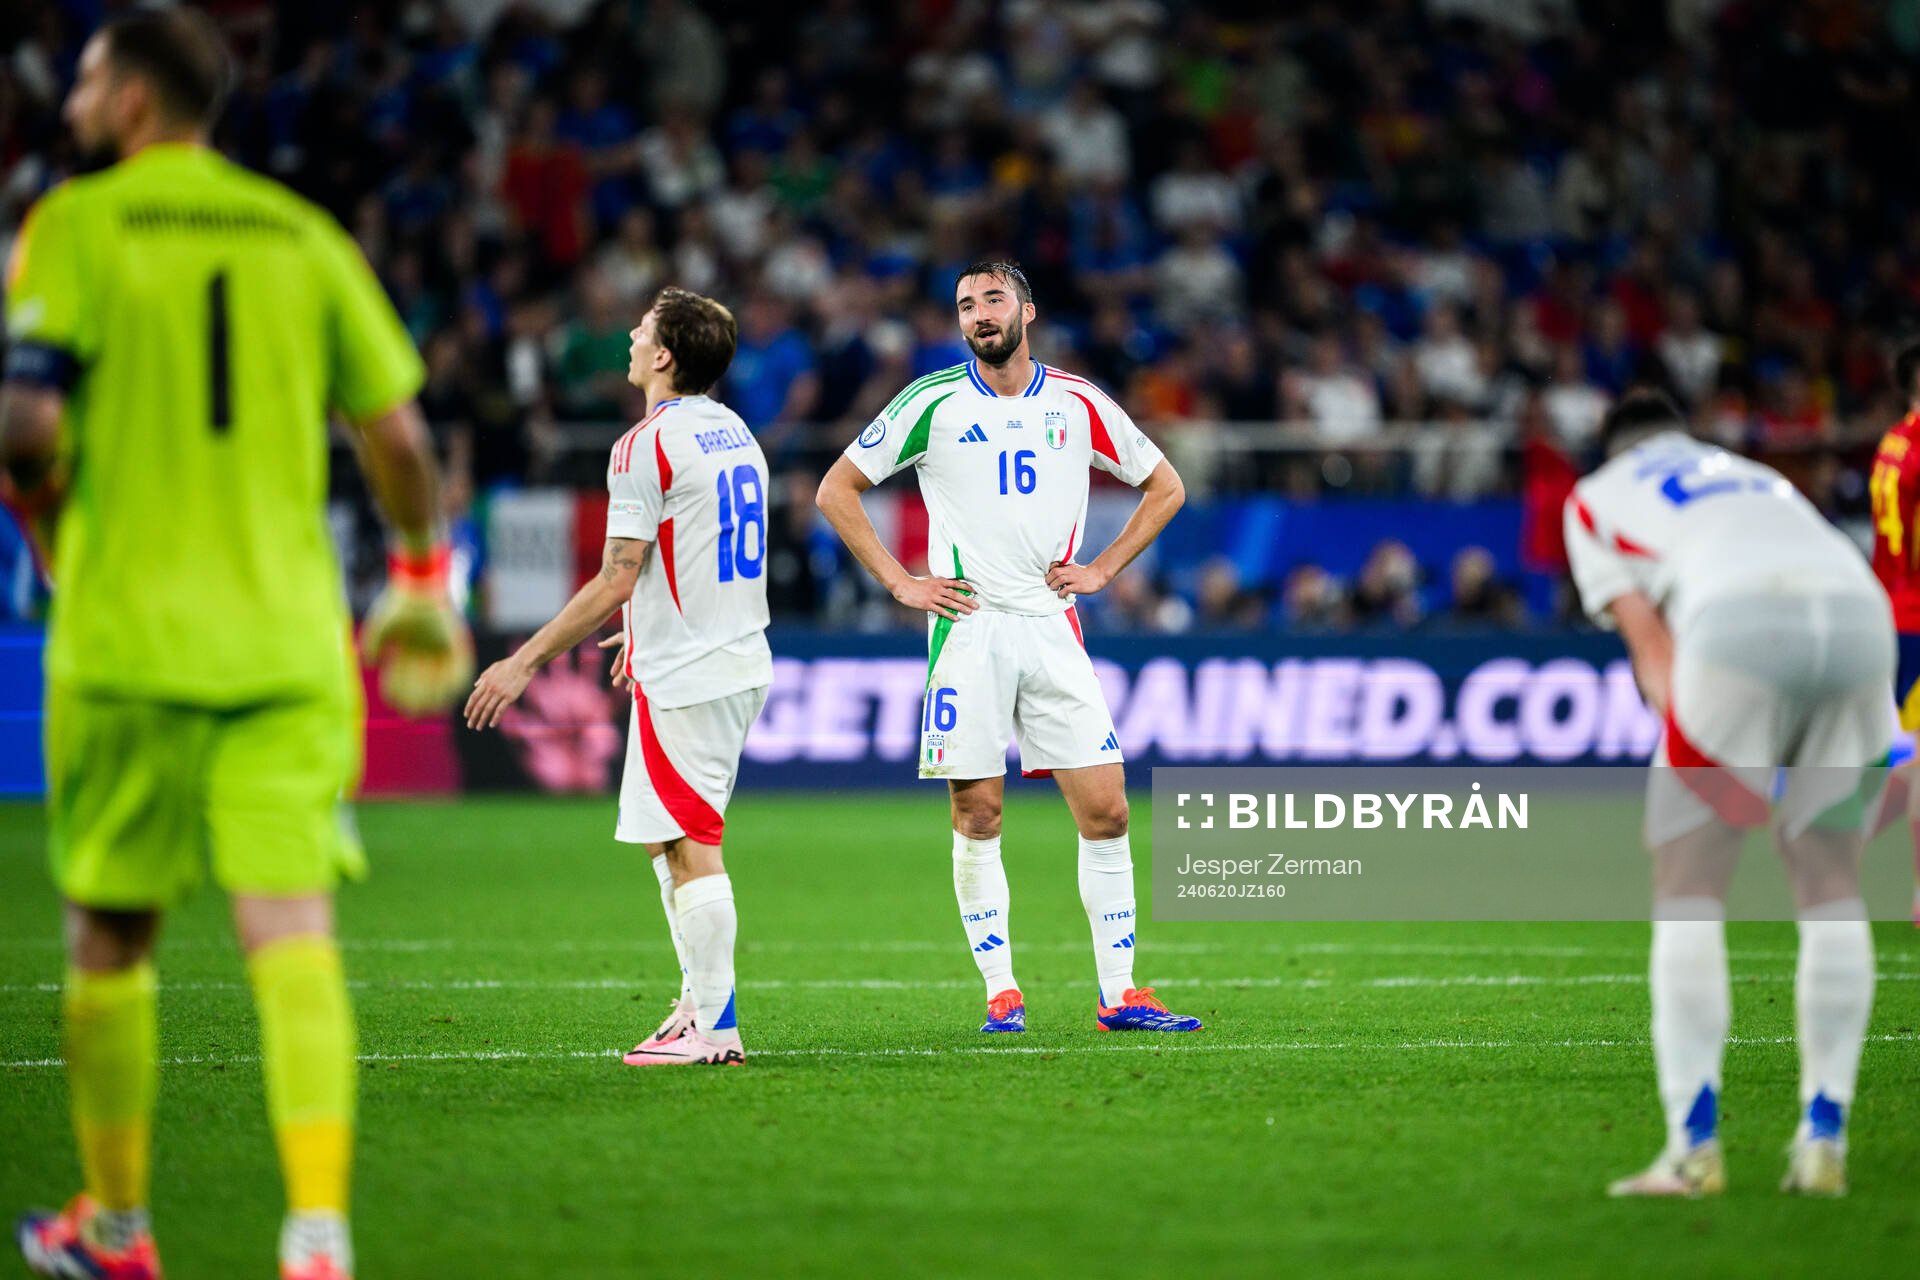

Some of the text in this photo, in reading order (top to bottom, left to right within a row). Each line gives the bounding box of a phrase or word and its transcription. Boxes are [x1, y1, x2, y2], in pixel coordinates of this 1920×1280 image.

[207, 269, 233, 434] 1
[694, 426, 755, 455] BARELLA
[998, 449, 1037, 496] 16
[717, 464, 765, 583] 18
[924, 687, 959, 733] 16
[961, 909, 998, 923] TALIA
[1103, 908, 1136, 922] ITALI
